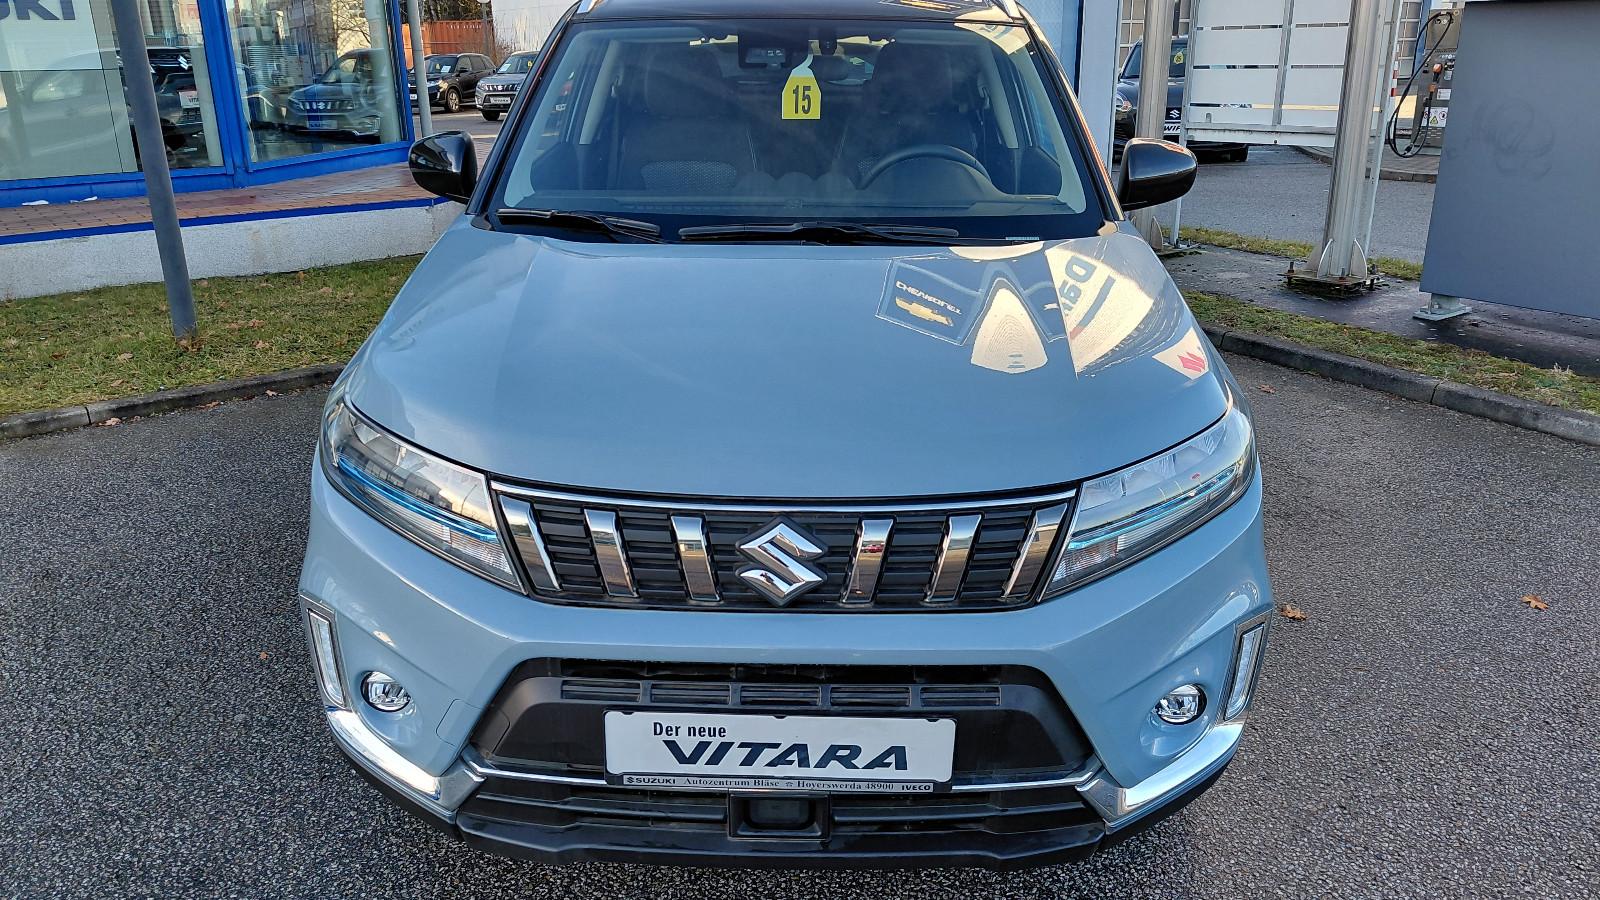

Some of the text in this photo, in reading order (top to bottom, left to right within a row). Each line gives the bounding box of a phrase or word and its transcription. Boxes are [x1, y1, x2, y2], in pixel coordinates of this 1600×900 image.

[792, 85, 812, 114] 15
[652, 722, 726, 738] Der neue
[662, 739, 908, 770] VITARA
[635, 777, 676, 785] SUZUKI
[683, 778, 750, 786] Autozentrum
[754, 779, 780, 787] Bläse
[797, 780, 862, 790] Hoyerswerda
